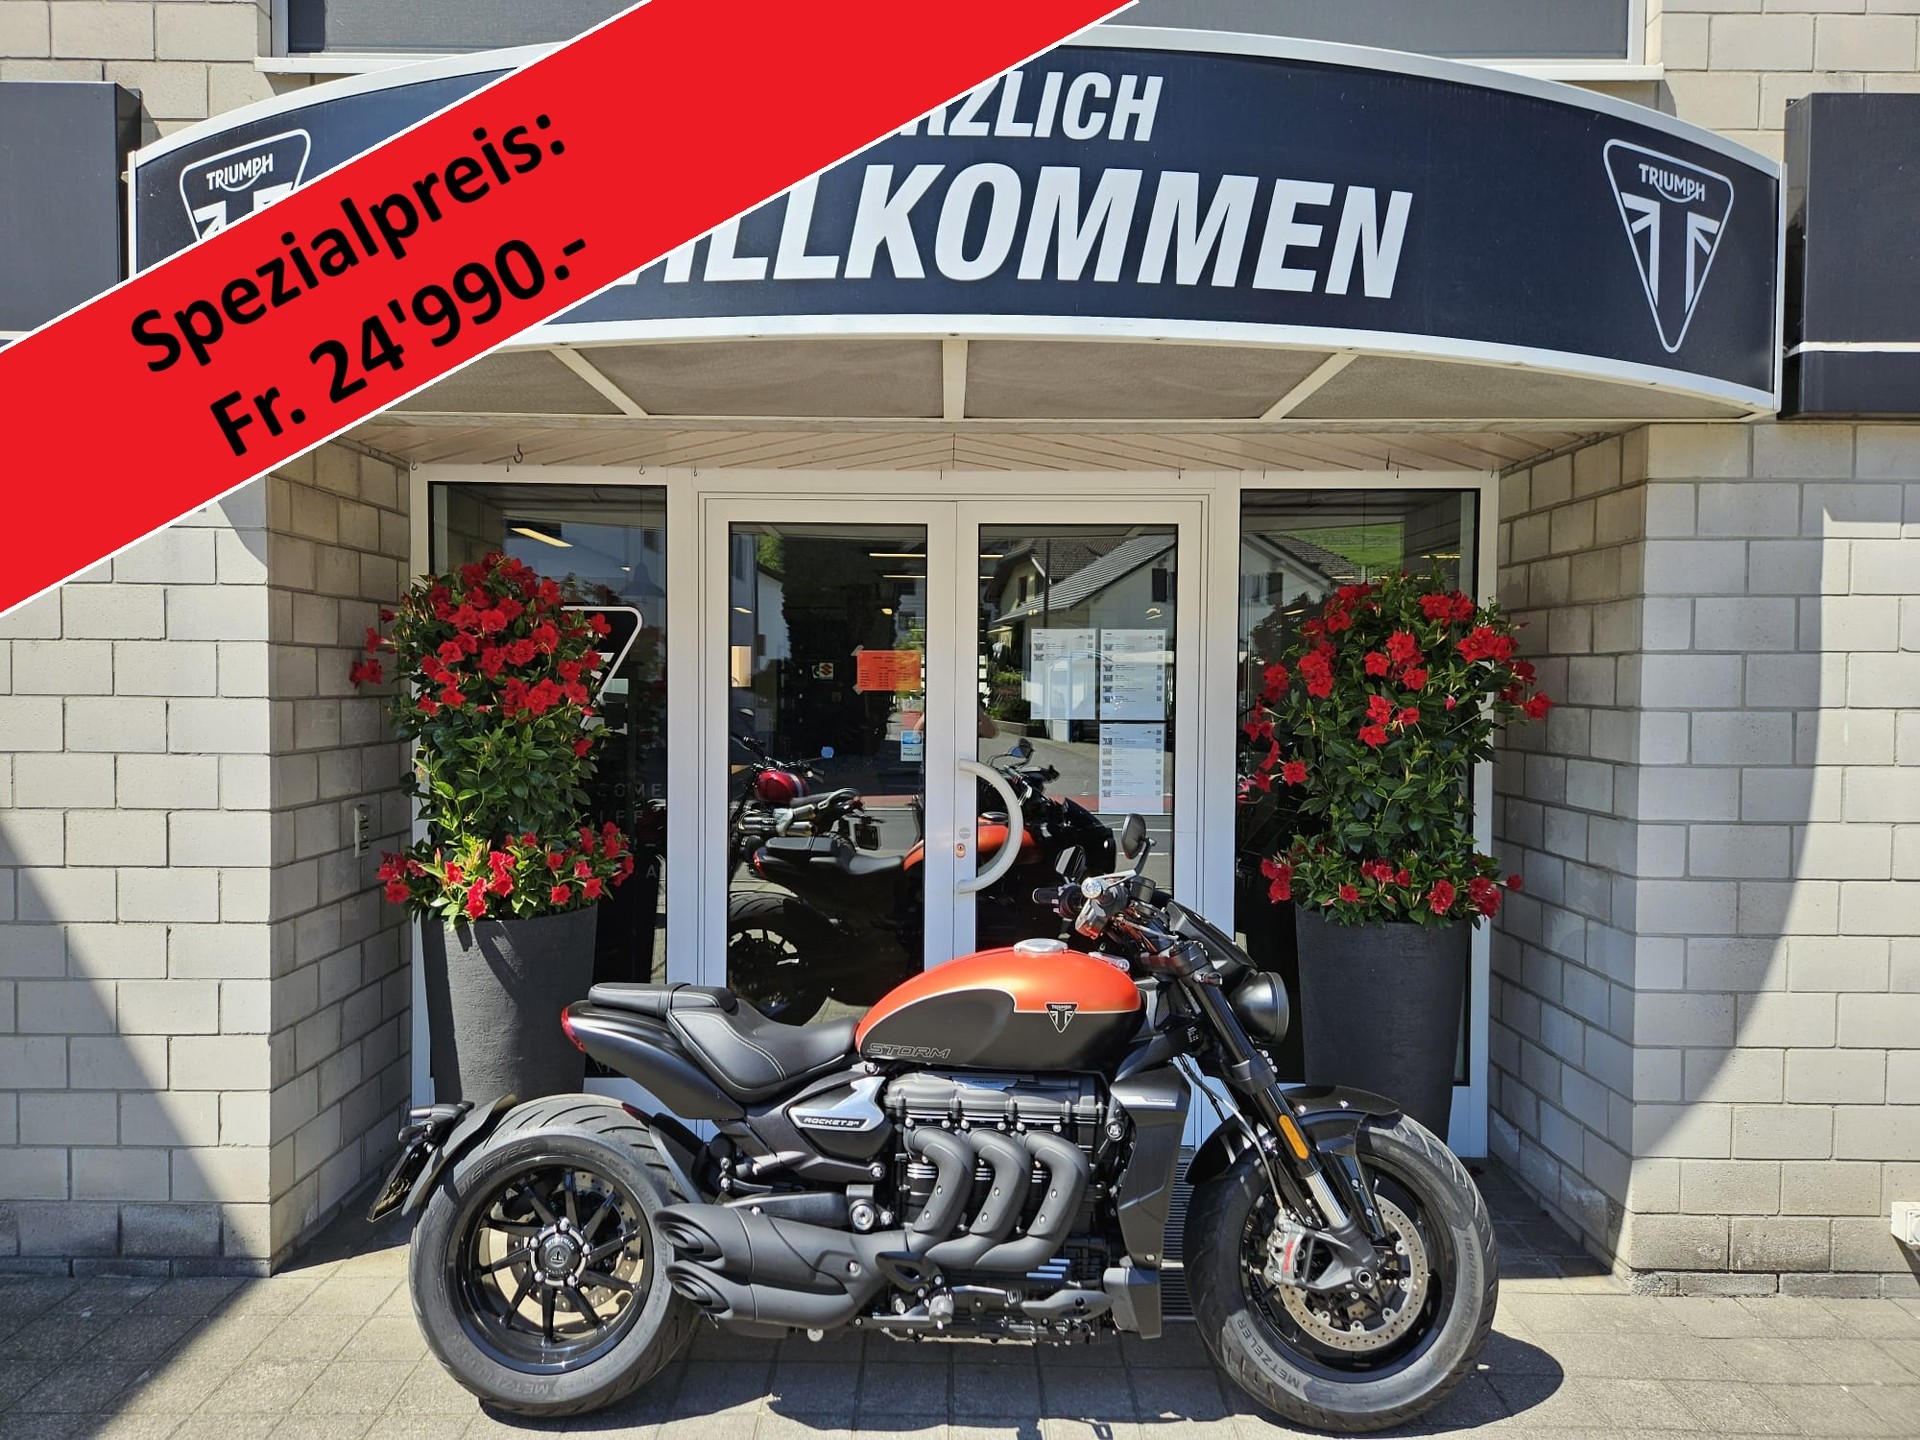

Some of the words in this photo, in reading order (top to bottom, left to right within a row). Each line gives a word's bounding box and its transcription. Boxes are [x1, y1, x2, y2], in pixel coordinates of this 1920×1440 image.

[901, 70, 1164, 142] ZLICH
[206, 153, 274, 192] TRIUMPH
[1638, 163, 1706, 203] TRIUMPH
[616, 162, 1413, 299] LLKOMMEN
[867, 1043, 951, 1059] STORM
[1237, 1317, 1301, 1389] METZELER
